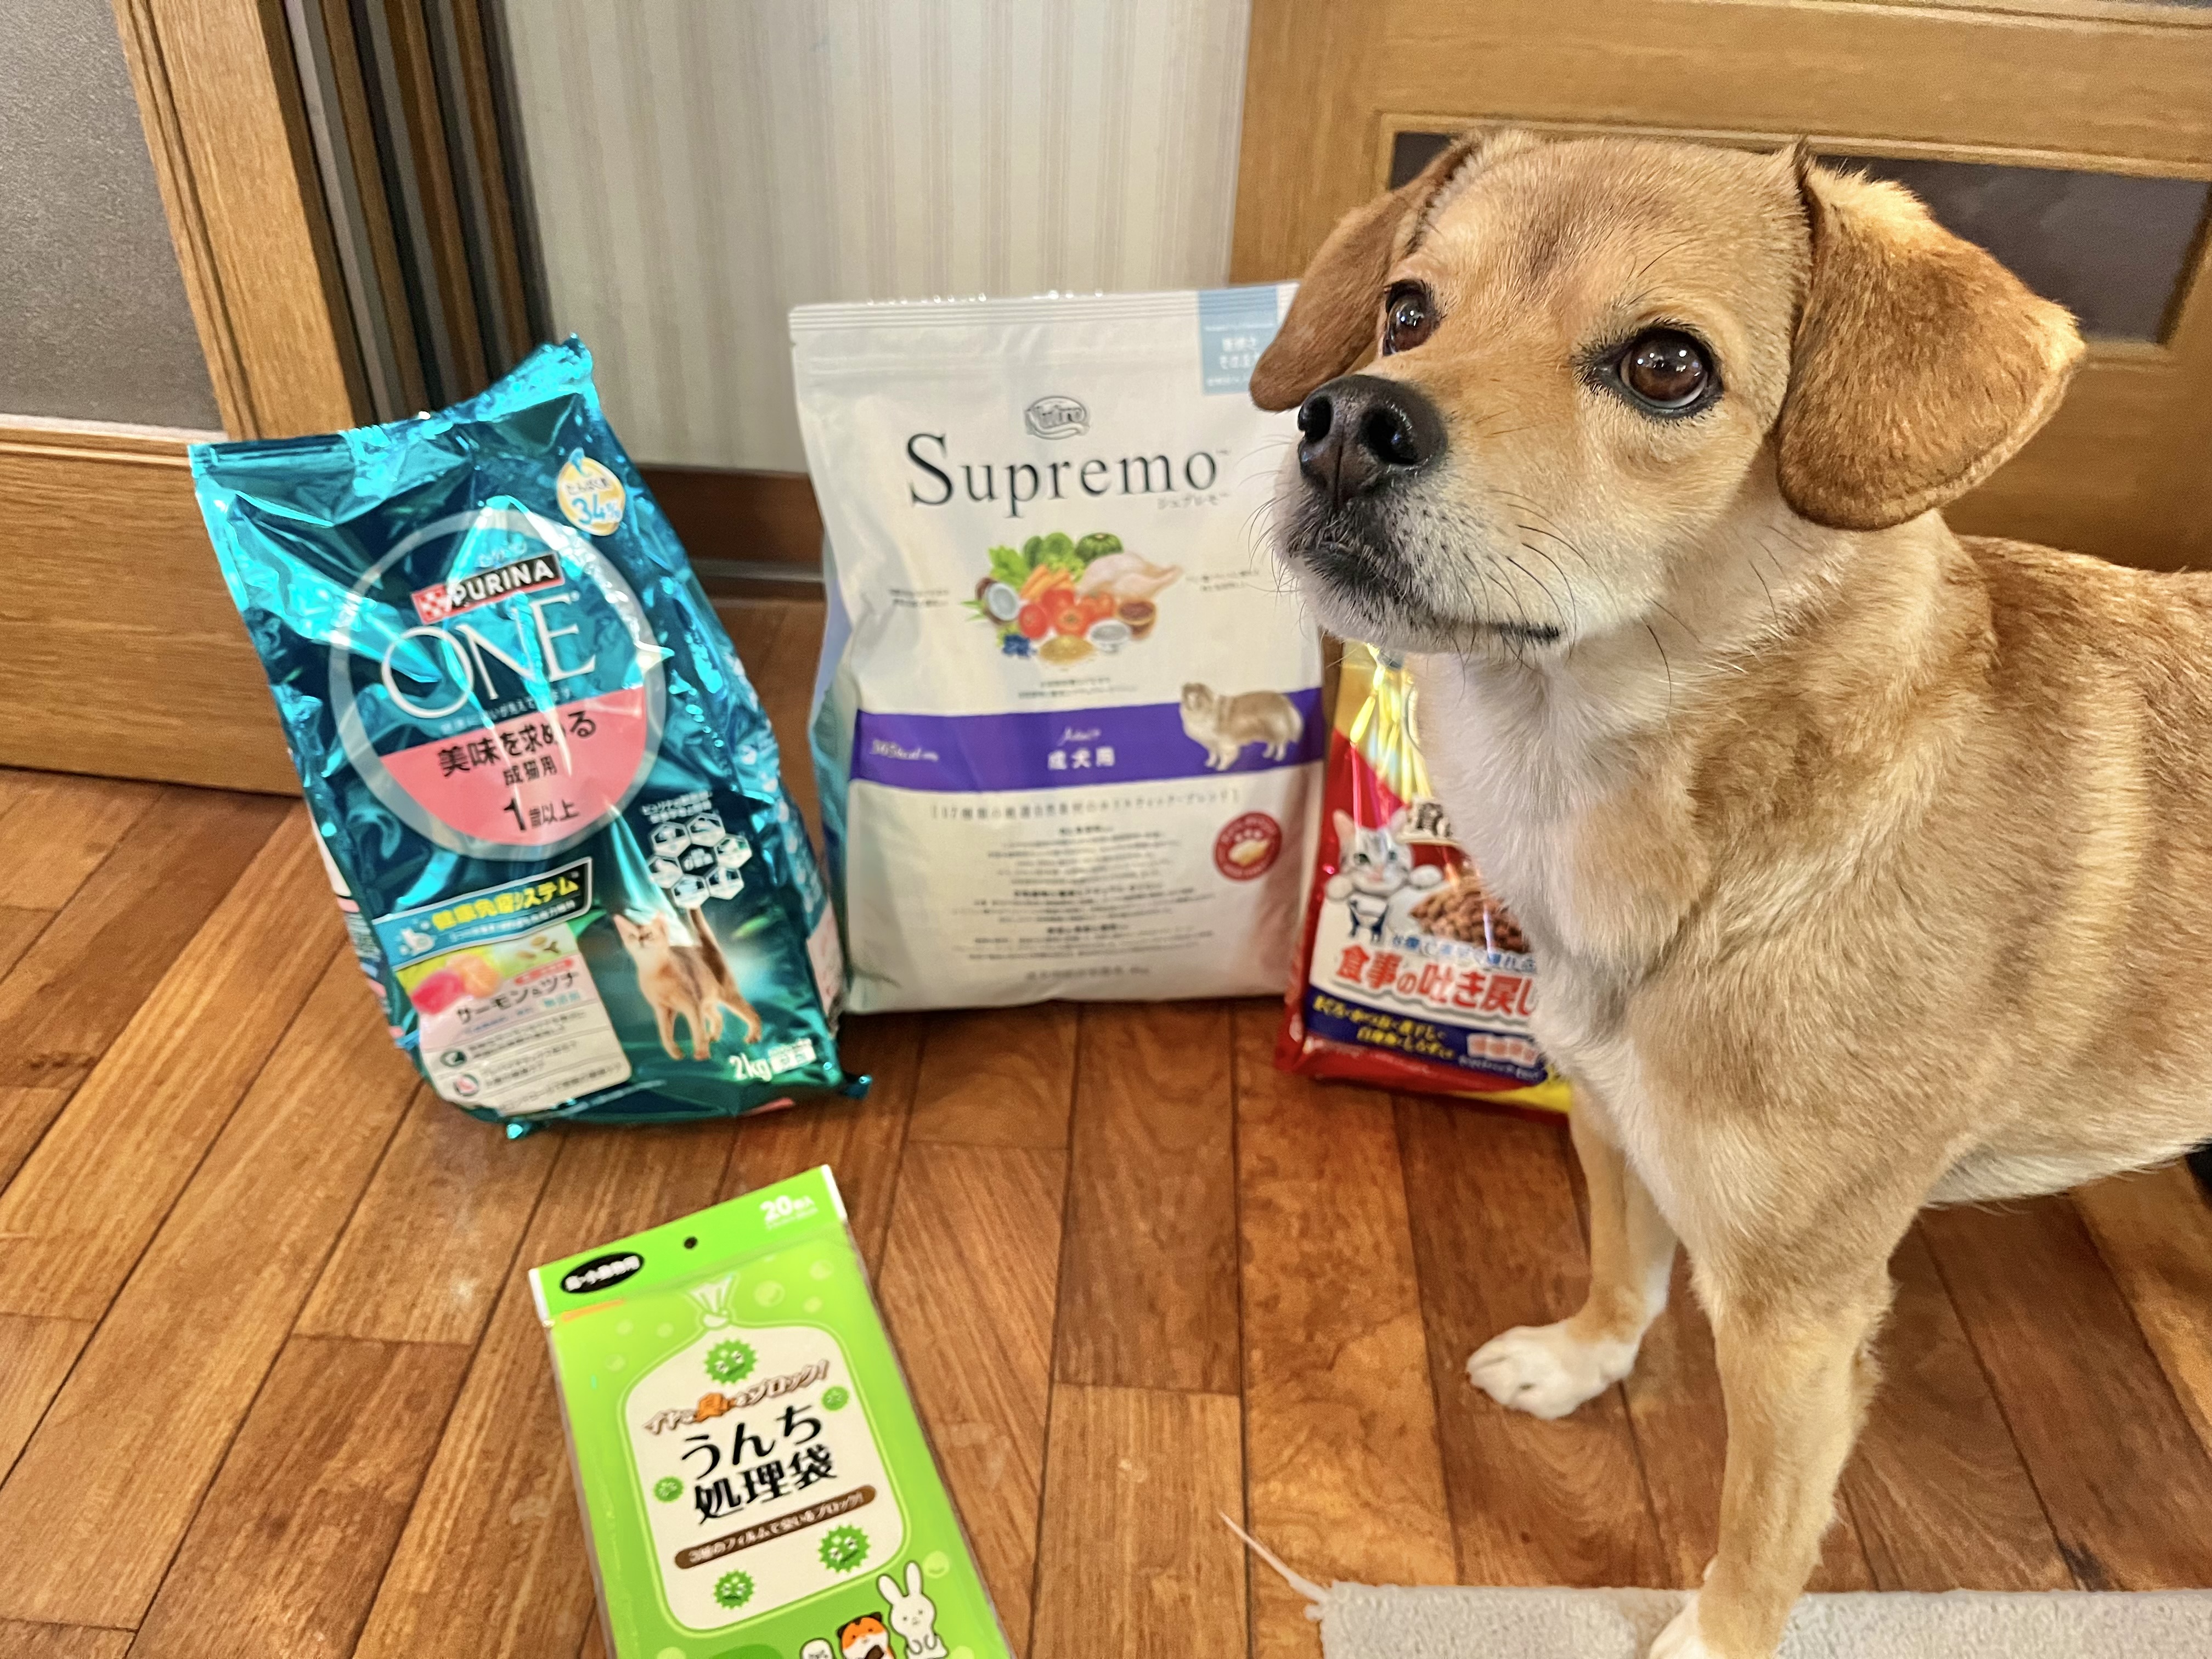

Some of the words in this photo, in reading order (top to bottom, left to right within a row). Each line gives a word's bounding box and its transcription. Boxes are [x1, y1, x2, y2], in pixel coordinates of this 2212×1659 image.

[907, 433, 1217, 518] Supremo
[450, 557, 554, 607] PURINA
[381, 592, 596, 719] ONE
[1047, 746, 1116, 770] 成犬用
[729, 1052, 772, 1082] 2kg
[681, 1405, 822, 1480] うんち
[693, 1443, 838, 1527] 処理袋
